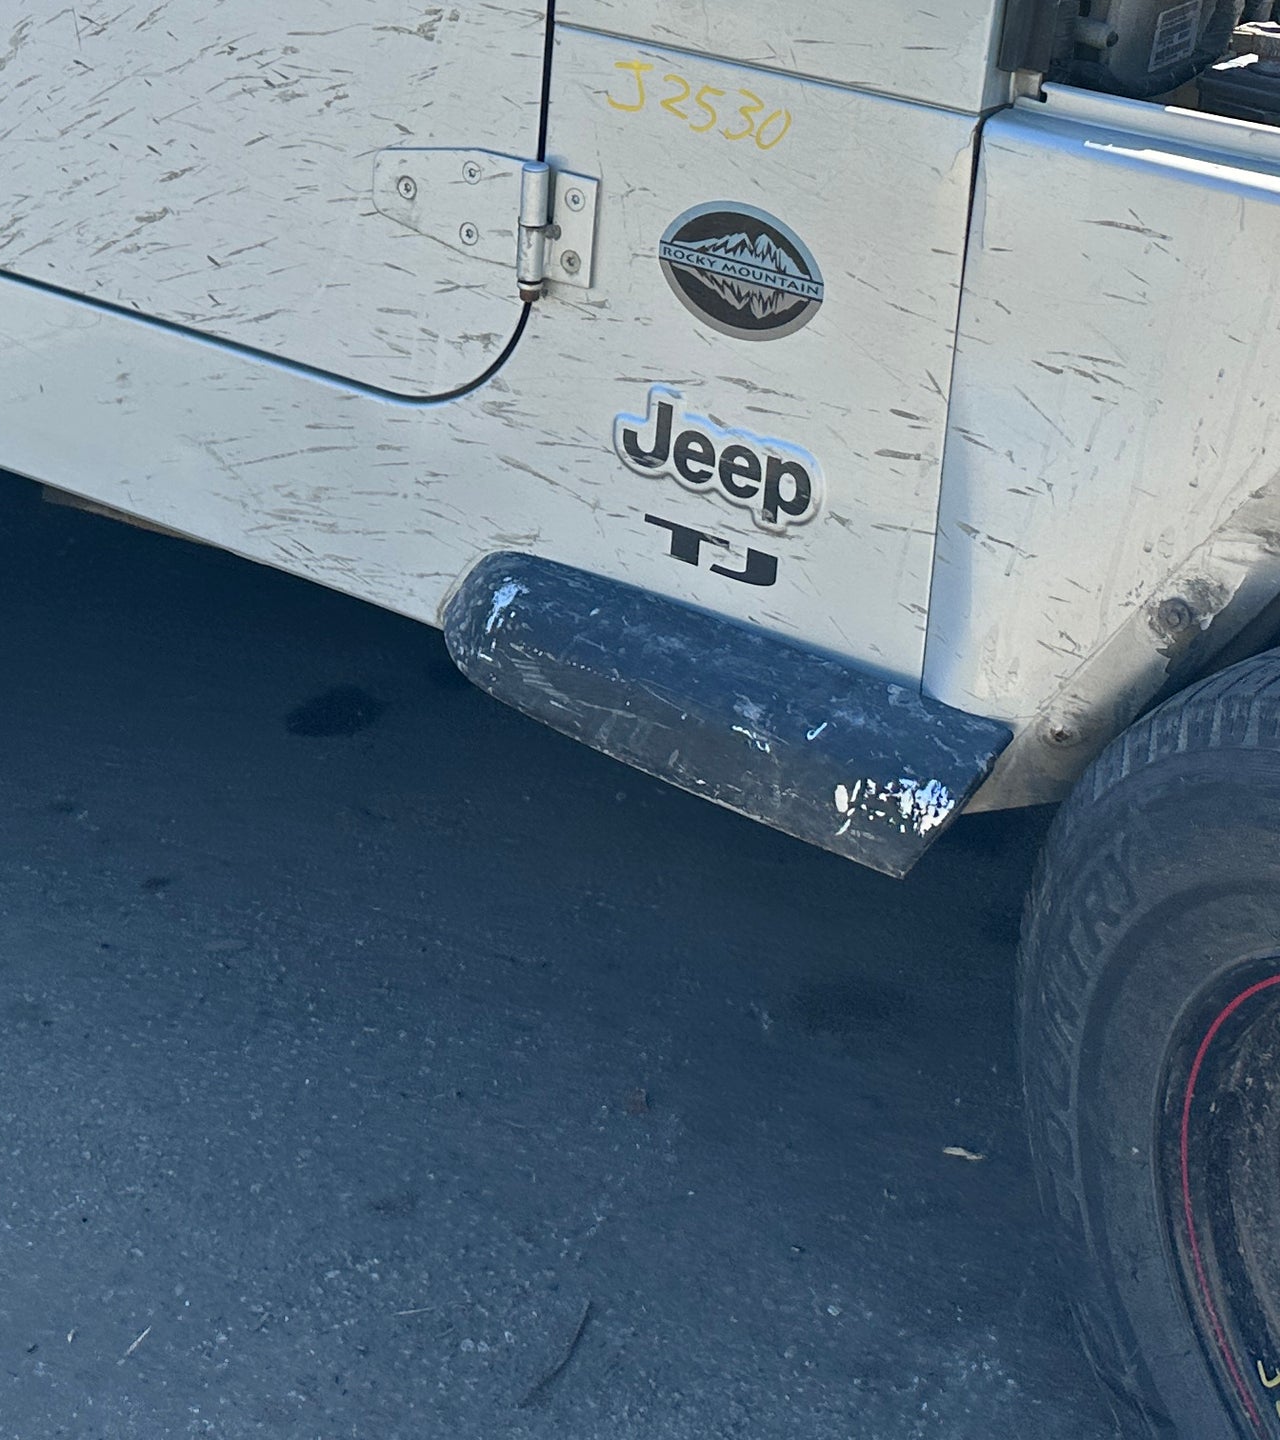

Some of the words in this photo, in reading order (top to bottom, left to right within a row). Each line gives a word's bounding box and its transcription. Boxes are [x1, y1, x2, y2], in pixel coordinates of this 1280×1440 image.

[607, 59, 793, 150] J2530
[662, 245, 717, 269] ROCKY
[721, 263, 820, 296] MOUNTAIN
[622, 400, 813, 525] Jeep
[643, 513, 779, 588] TJ
